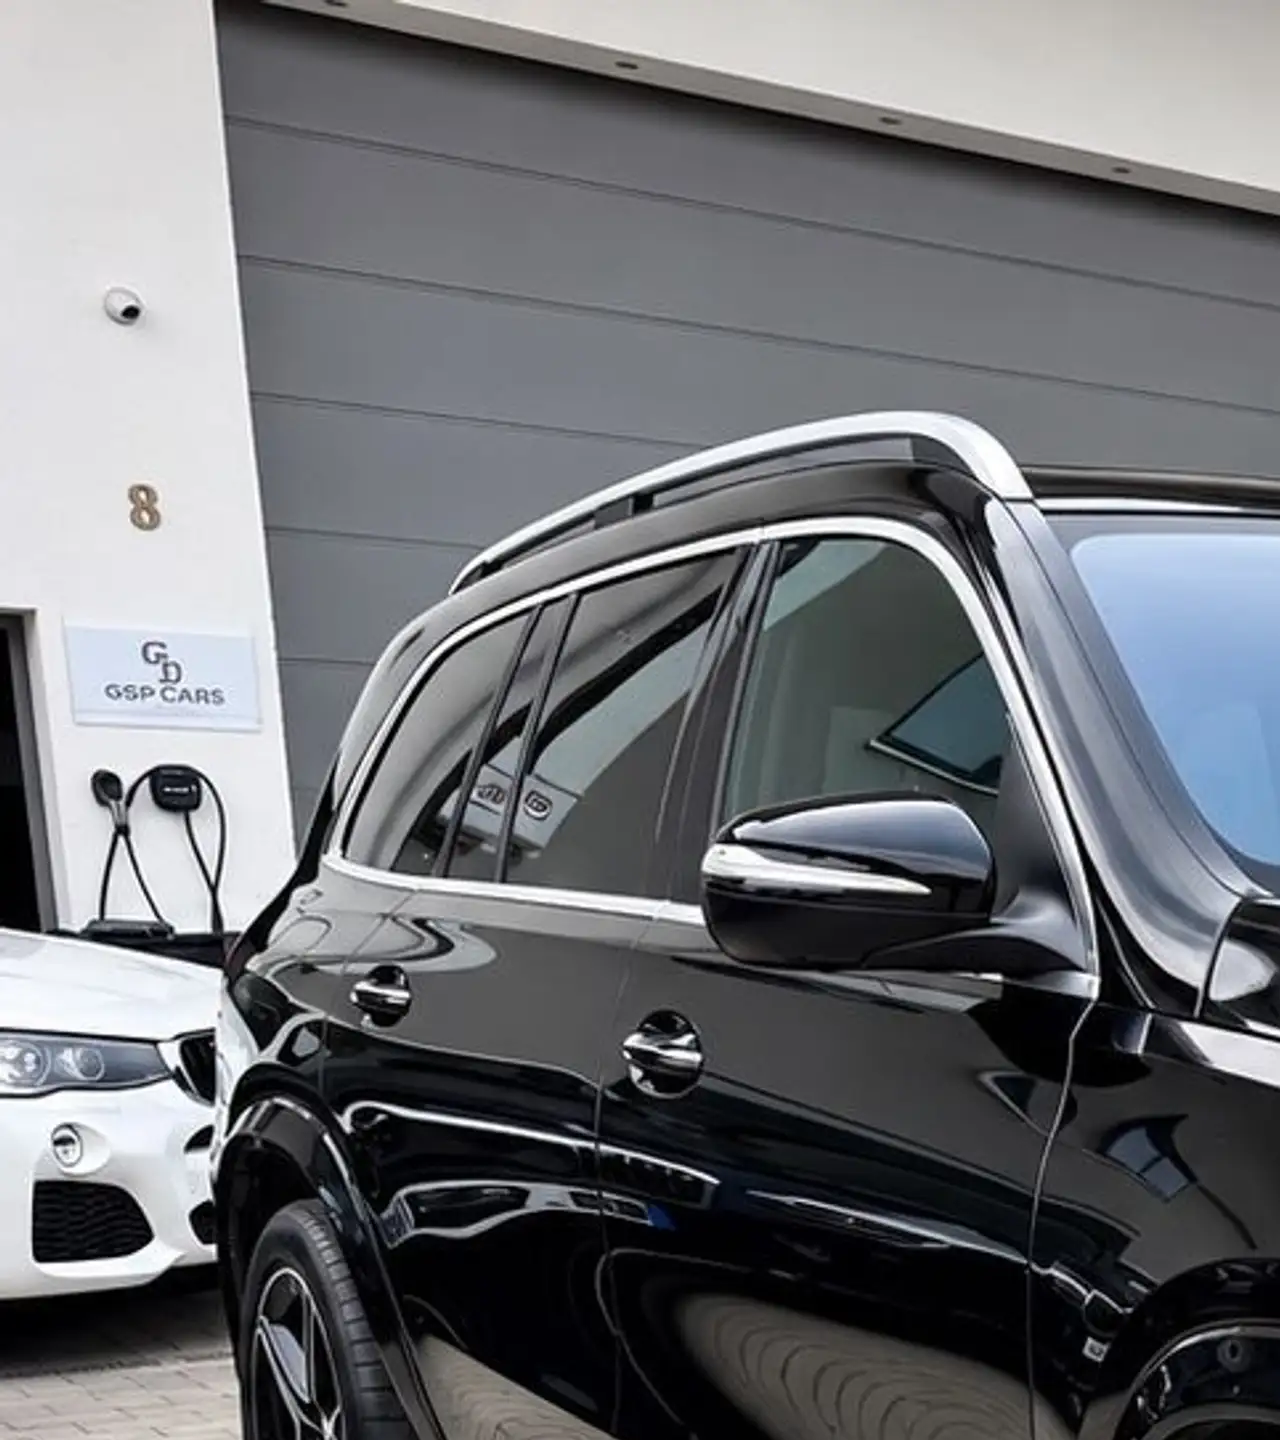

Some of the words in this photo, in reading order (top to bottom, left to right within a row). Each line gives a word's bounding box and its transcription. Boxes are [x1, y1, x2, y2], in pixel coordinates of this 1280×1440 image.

[128, 484, 161, 531] 8
[104, 683, 156, 701] GSP
[160, 685, 226, 706] CARS
